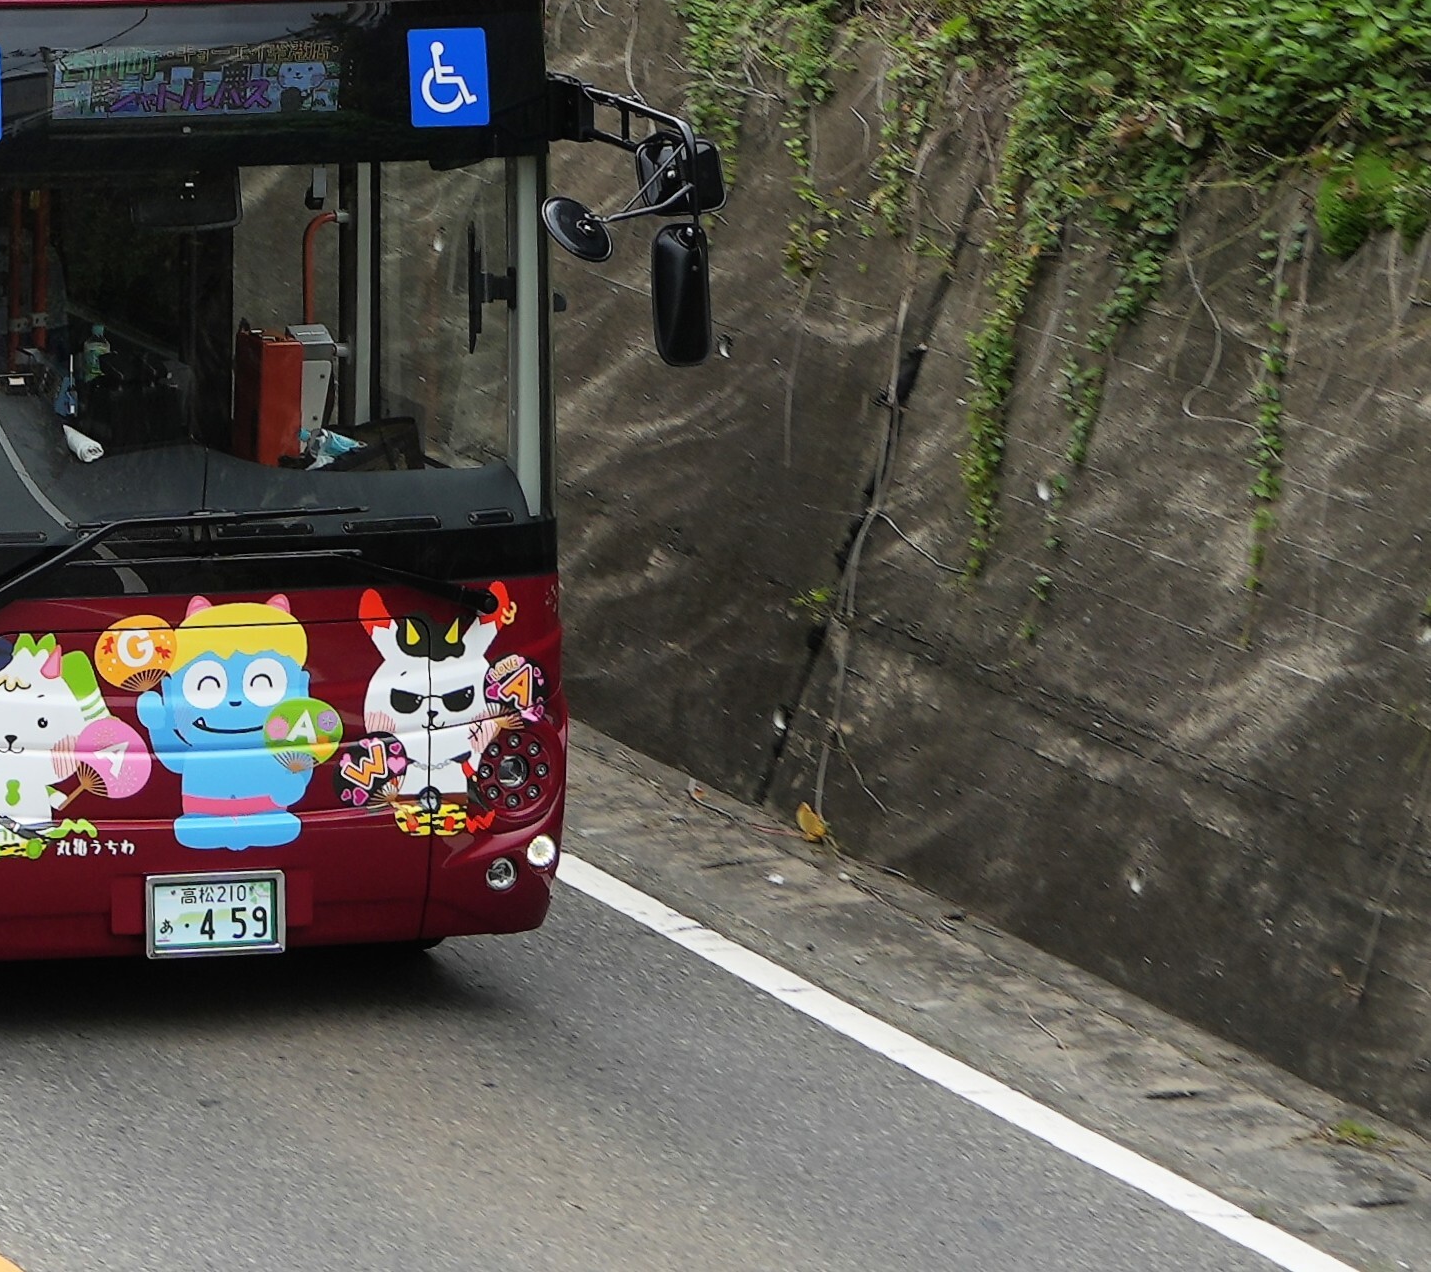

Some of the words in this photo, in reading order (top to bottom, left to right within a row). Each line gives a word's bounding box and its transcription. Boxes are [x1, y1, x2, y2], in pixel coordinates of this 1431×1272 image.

[117, 630, 155, 668] G
[499, 665, 532, 708] A
[285, 708, 318, 744] A
[93, 740, 131, 780] A
[340, 741, 389, 789] W
[55, 838, 136, 856] 丸亀うちわ
[180, 885, 247, 905] 高松210
[159, 918, 174, 935] あ
